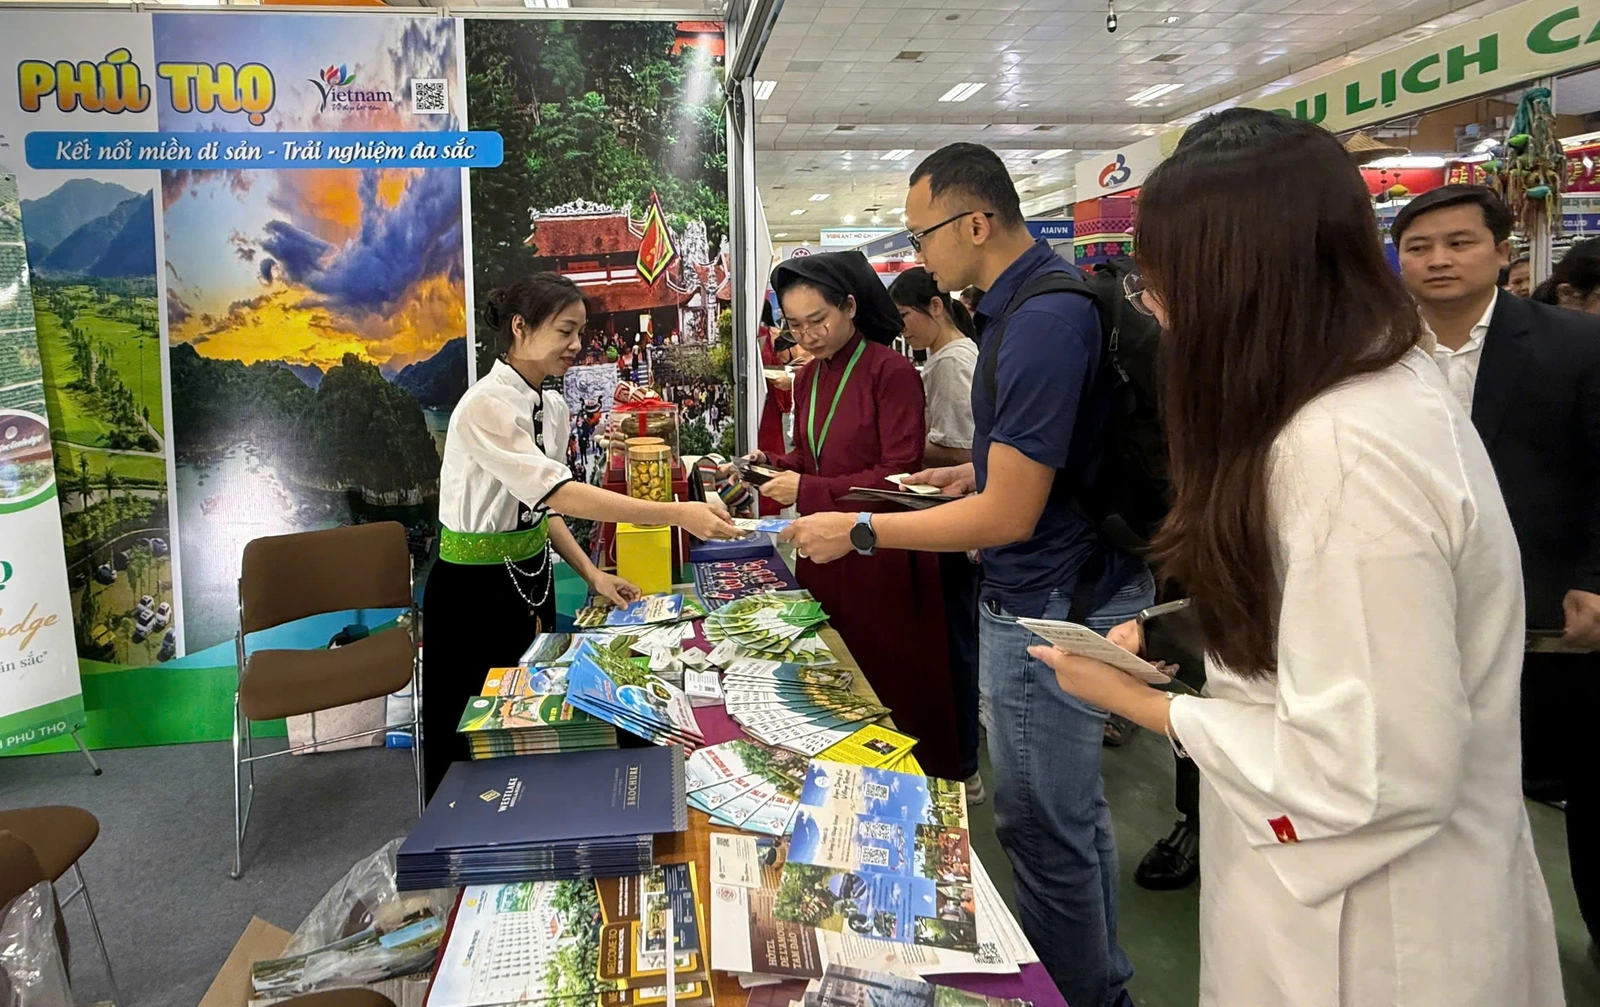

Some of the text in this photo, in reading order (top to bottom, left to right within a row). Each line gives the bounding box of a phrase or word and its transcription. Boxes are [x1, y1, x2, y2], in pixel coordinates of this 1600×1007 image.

[1271, 6, 1600, 124] U LỊCH C
[18, 47, 275, 126] PHÚ THỌ
[307, 79, 392, 113] Vietnam
[56, 139, 91, 160] Kết
[98, 139, 133, 160] nối
[139, 137, 192, 160] miền
[198, 140, 219, 160] di
[223, 140, 263, 160] sản
[283, 140, 322, 160] Trải
[327, 140, 406, 164] nghiệm
[410, 141, 437, 159] đa
[441, 137, 475, 159] sắc
[7, 721, 66, 746] PHÚ THỌ
[498, 776, 519, 813] WESTLAKE
[627, 766, 639, 806] BROCHURE
[609, 928, 617, 939] TO
[607, 940, 617, 976] WELCOME
[766, 939, 777, 966] HÔTEL
[781, 955, 789, 967] DE
